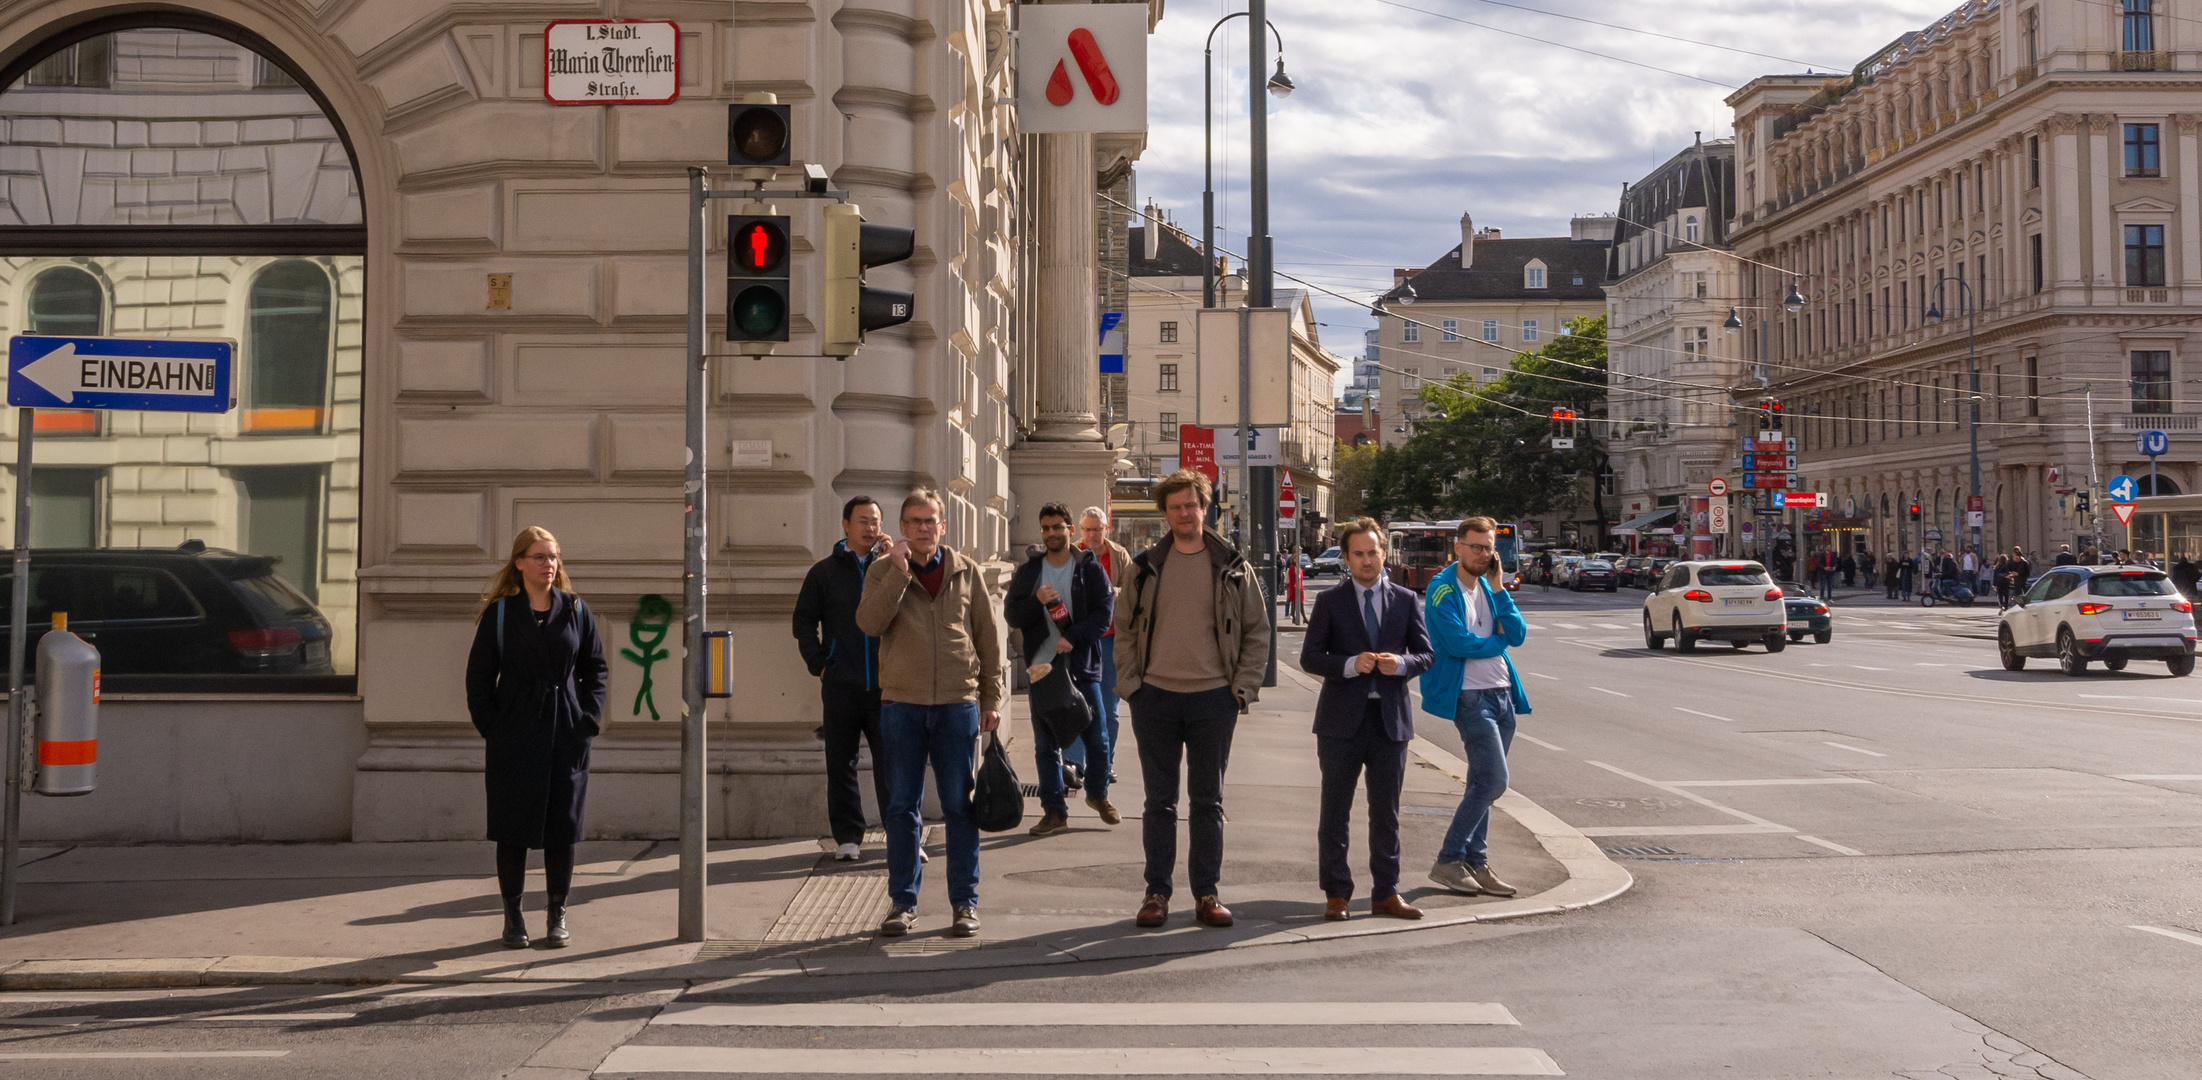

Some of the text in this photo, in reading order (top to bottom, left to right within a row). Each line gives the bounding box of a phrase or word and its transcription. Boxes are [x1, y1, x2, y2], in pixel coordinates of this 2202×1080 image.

[596, 24, 641, 40] Stadt.
[549, 46, 675, 79] Maria Theresien-
[894, 304, 905, 316] 13
[81, 359, 204, 391] EINBAHN
[2148, 435, 2164, 452] U
[1757, 459, 1783, 467] Freyung
